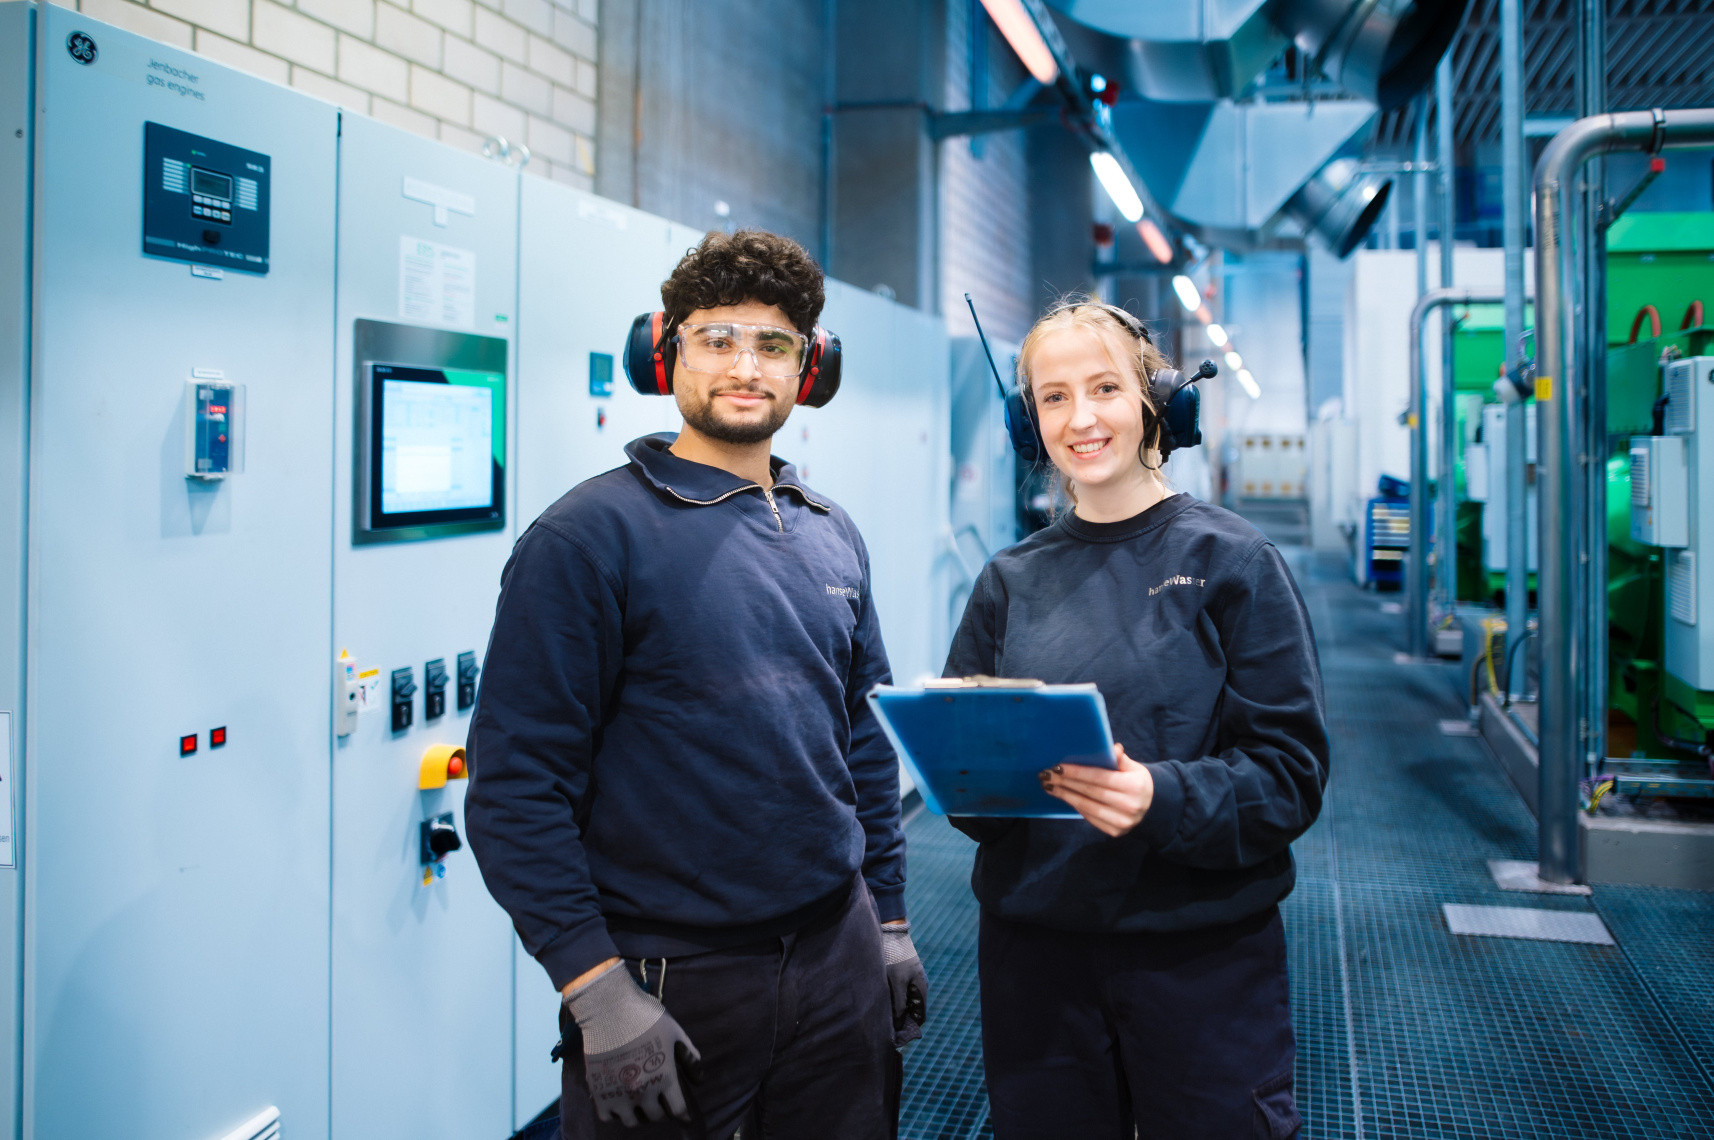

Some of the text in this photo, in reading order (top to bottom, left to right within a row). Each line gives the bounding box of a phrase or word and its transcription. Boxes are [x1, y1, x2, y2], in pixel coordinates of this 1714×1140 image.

[147, 59, 199, 84] Jenbacher
[146, 73, 206, 101] gas engines
[1148, 574, 1206, 597] haneWaser
